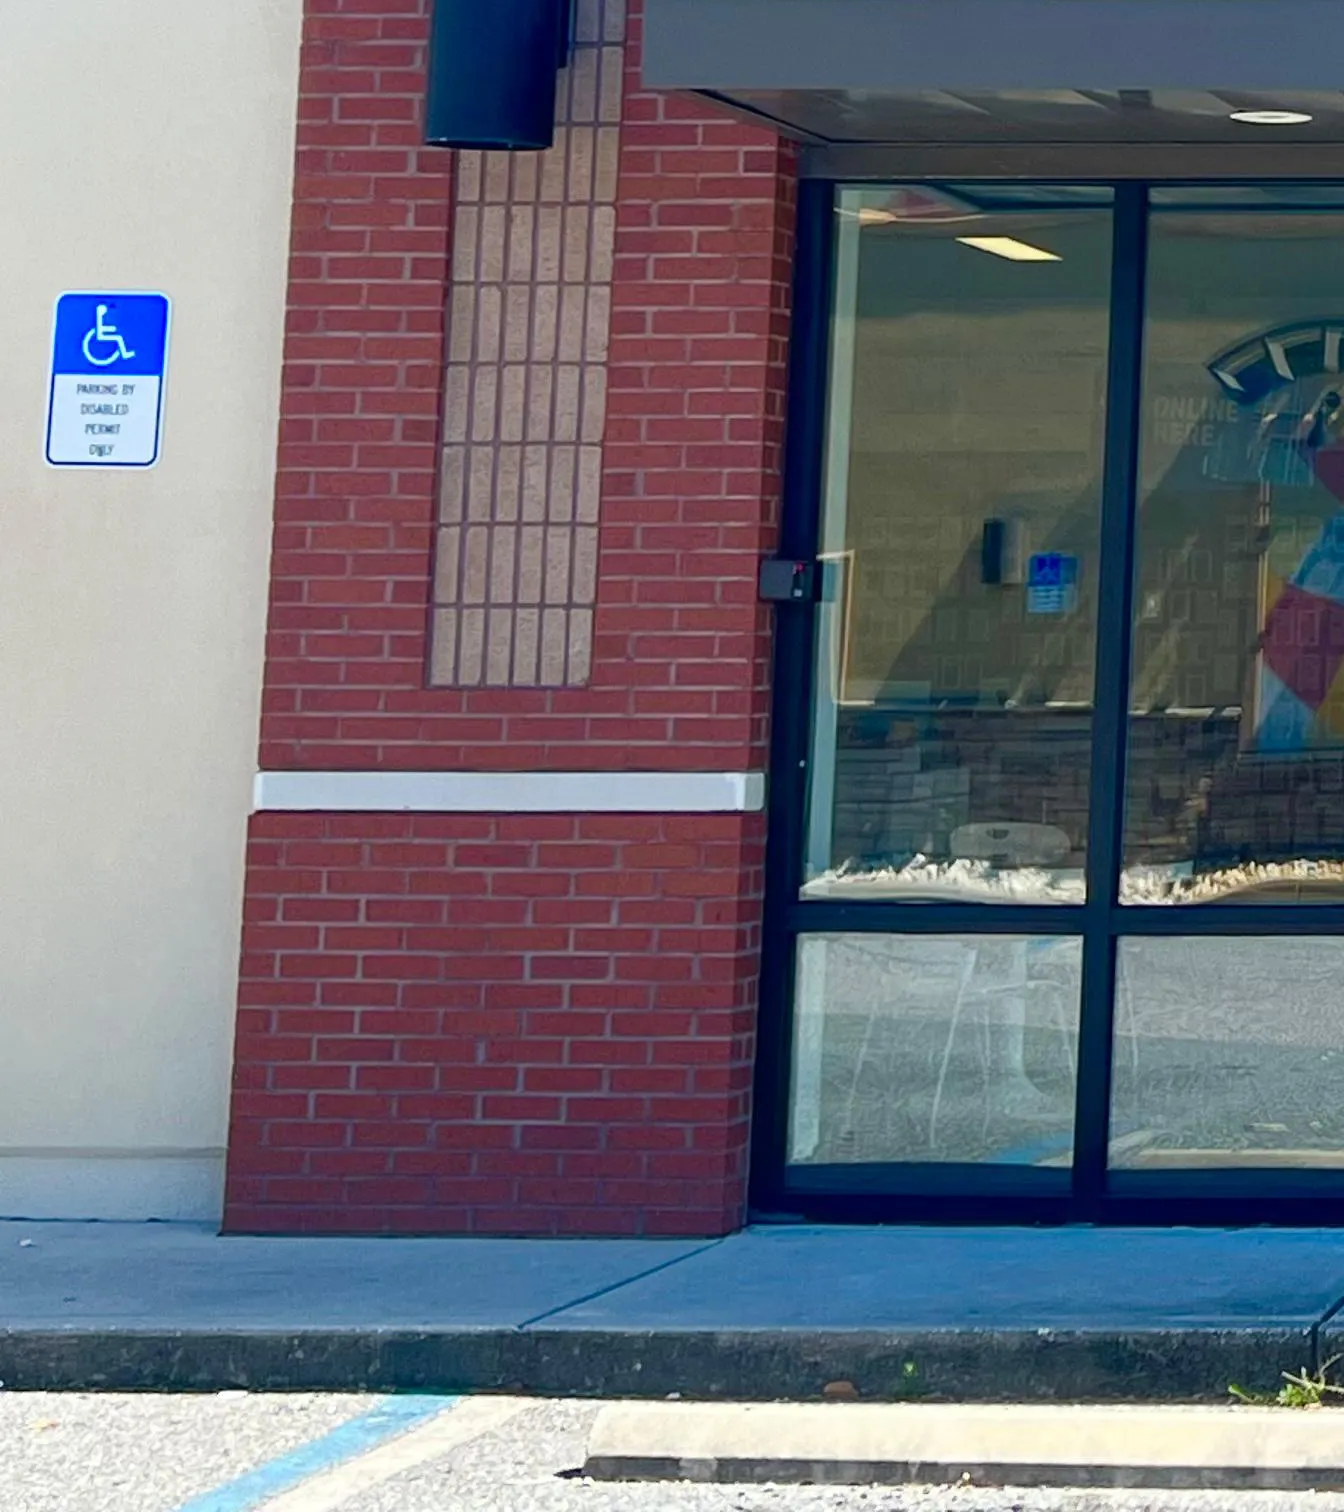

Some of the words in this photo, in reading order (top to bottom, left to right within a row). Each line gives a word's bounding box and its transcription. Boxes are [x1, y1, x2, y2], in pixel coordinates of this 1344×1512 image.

[76, 383, 118, 396] PARKING
[121, 383, 136, 396] BY
[80, 403, 130, 416] DISABLED
[84, 423, 121, 436] PERMIT
[88, 443, 115, 457] ONLY
